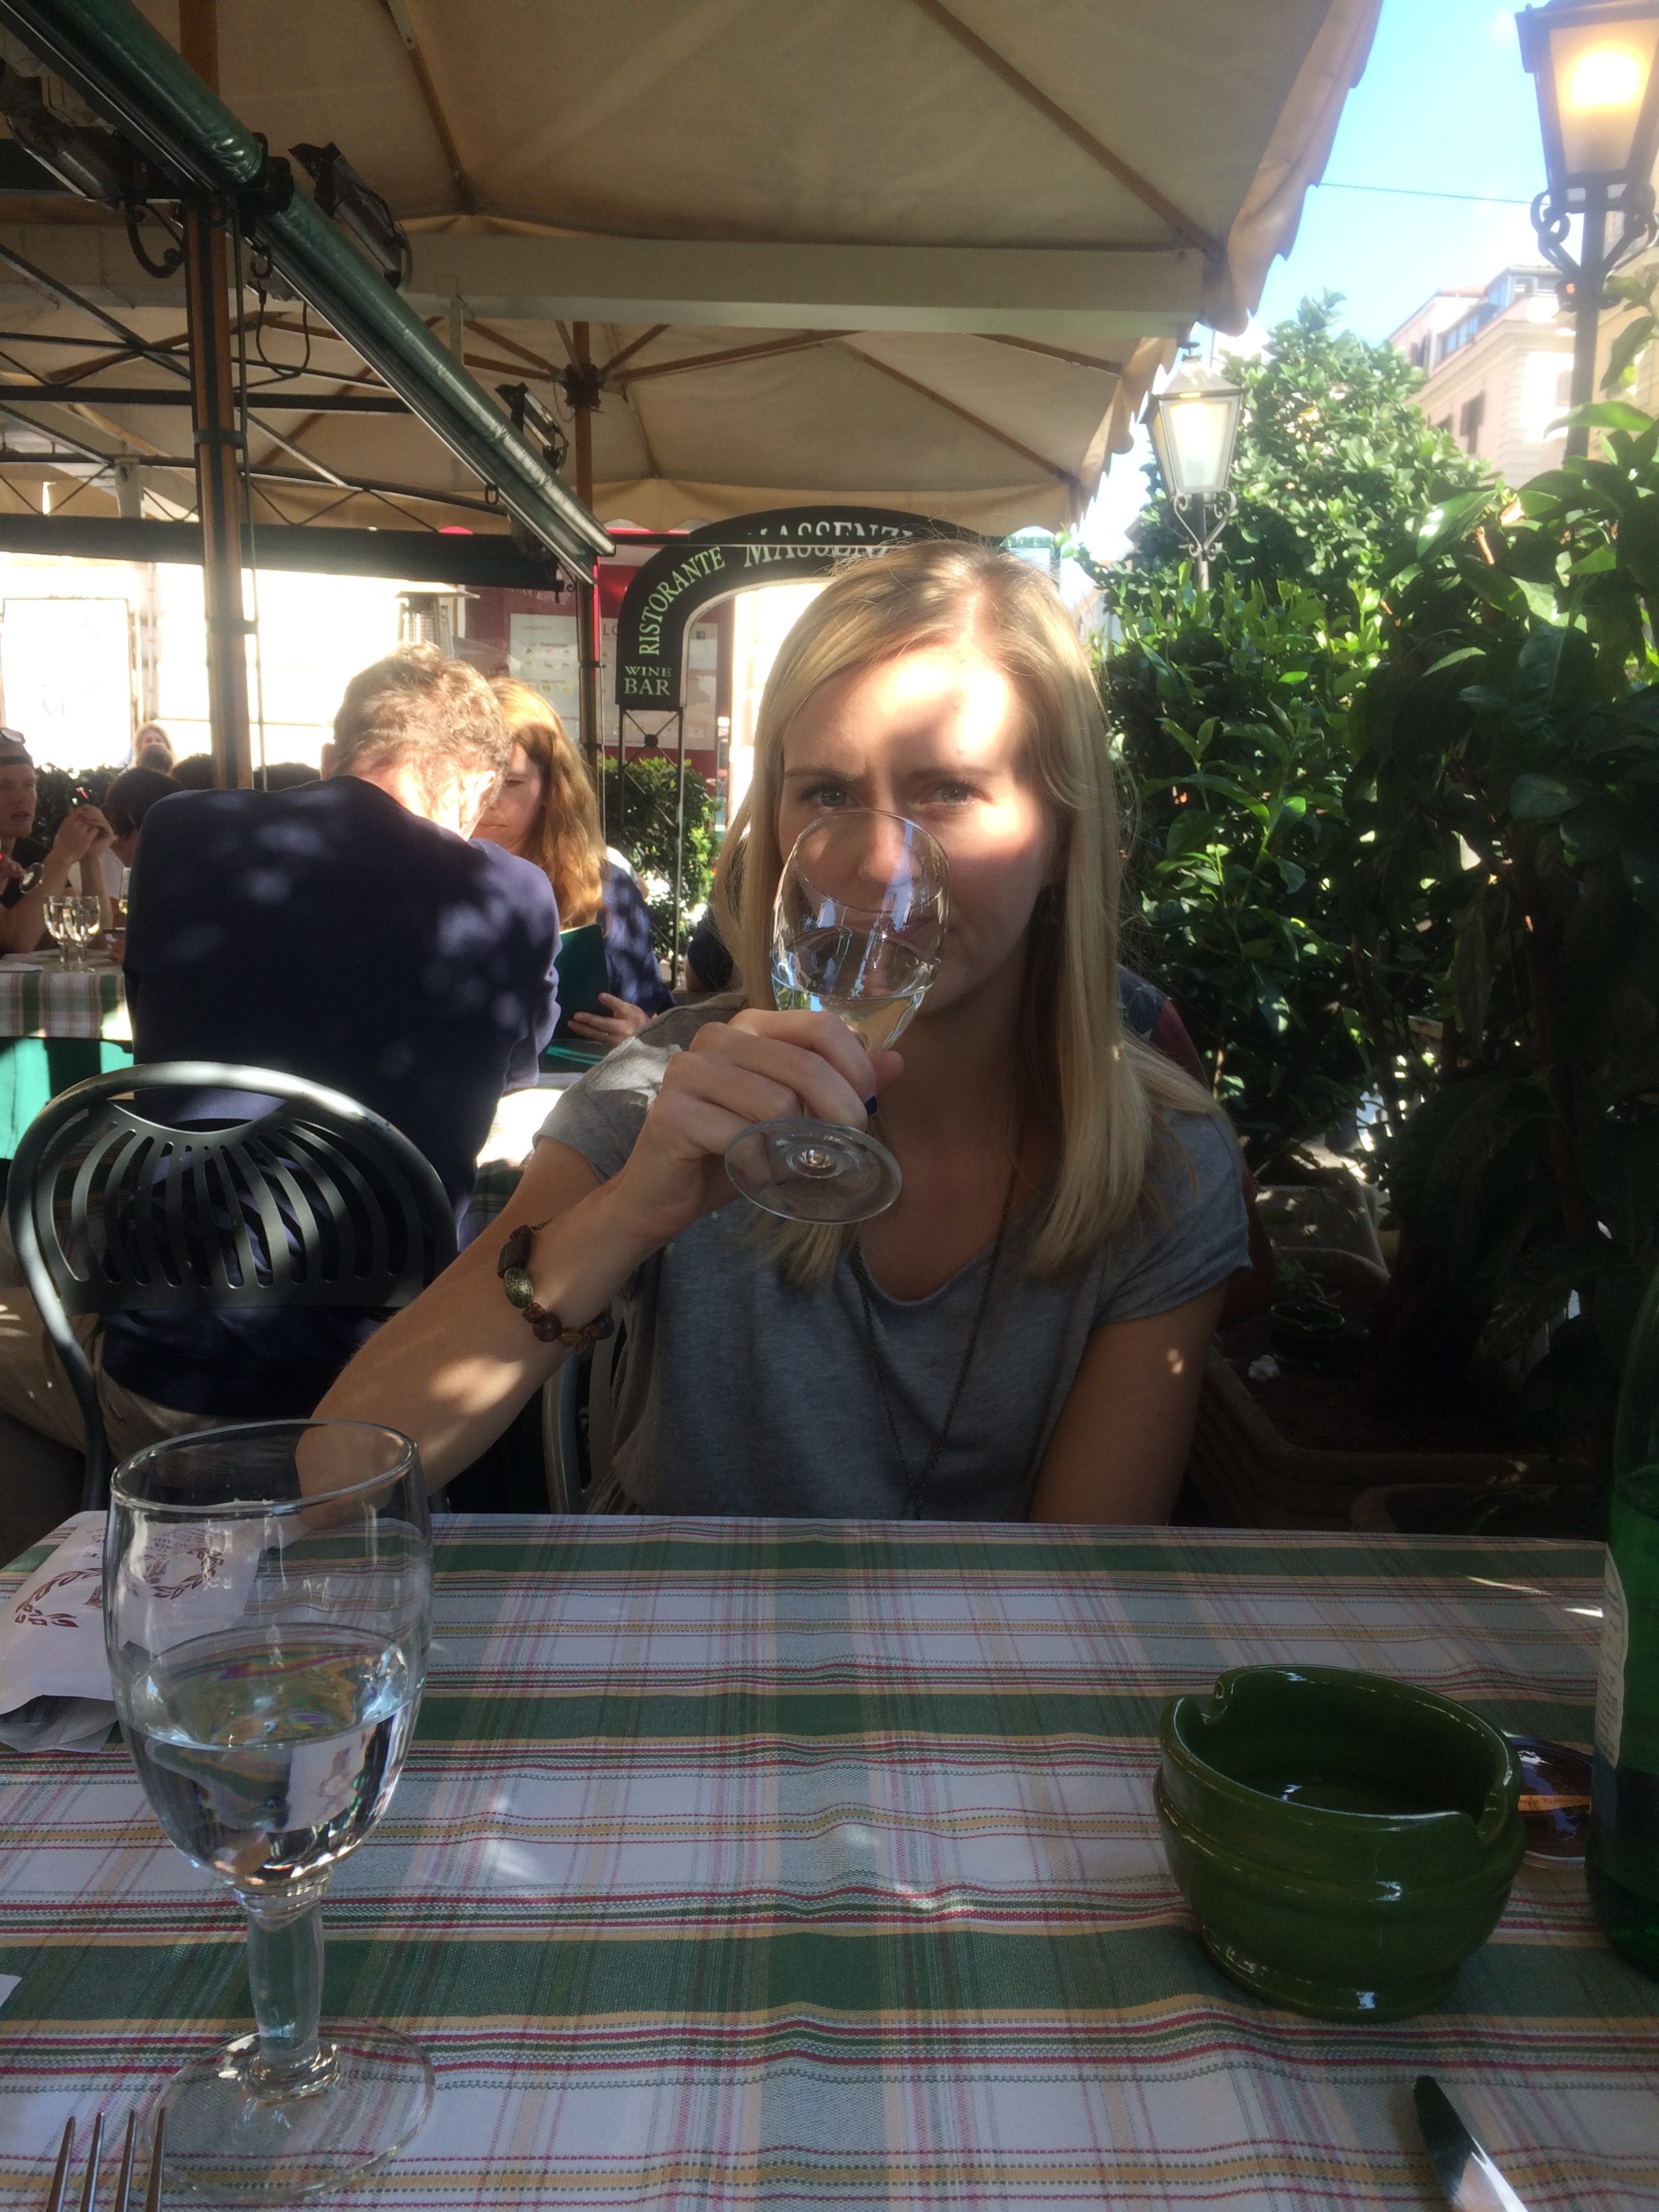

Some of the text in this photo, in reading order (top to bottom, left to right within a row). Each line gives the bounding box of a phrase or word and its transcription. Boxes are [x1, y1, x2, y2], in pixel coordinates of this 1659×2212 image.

[638, 546, 726, 656] RISTORANTE
[624, 665, 672, 677] WINE
[623, 678, 672, 696] BAR
